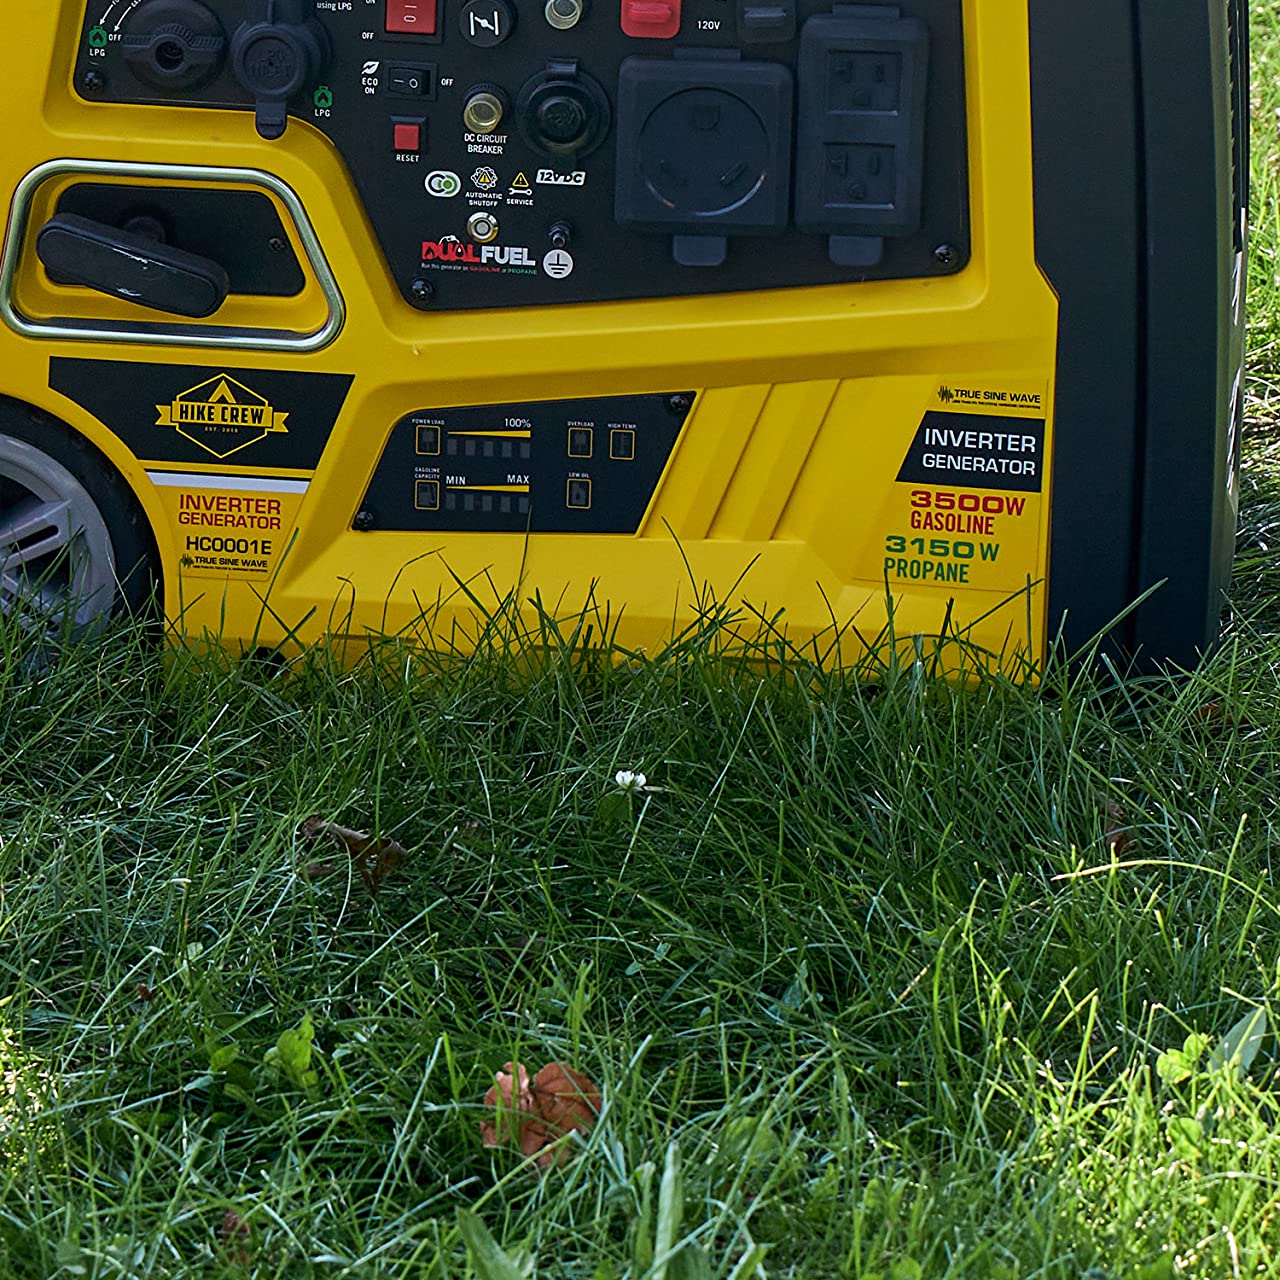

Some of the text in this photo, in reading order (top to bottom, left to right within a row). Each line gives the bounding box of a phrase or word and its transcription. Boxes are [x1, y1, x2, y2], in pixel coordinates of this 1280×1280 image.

[316, 1, 353, 12] using LPG
[696, 20, 721, 30] 120V
[108, 33, 122, 42] OFF
[361, 32, 375, 40] OFF
[89, 48, 106, 57] LPG
[361, 77, 378, 86] ECO
[440, 78, 454, 87] OFF
[364, 86, 375, 95] ON
[314, 108, 331, 118] LPG
[464, 133, 508, 144] DC CIRCUIT
[467, 144, 503, 155] BREAKER
[396, 154, 420, 163] RESET
[465, 191, 503, 200] AUTOMATIC
[468, 199, 498, 207] SHUTOFF
[506, 198, 534, 206] SERVICE
[422, 241, 536, 267] DUAL FUEL
[954, 388, 1041, 404] TRUE SINE WAVE
[179, 404, 265, 424] HIKE CREW
[504, 418, 531, 428] 100%
[925, 428, 1036, 453] INVERTER
[922, 453, 1036, 476] GENERATOR
[445, 475, 466, 486] MIN
[506, 474, 530, 484] MAX
[179, 494, 281, 515] INVERTER
[178, 512, 281, 530] GENERATOR
[910, 510, 995, 535] GASOLINE
[885, 535, 1000, 562] 3150 W
[195, 556, 268, 568] TRUE SINE WAVE
[884, 557, 969, 583] PROPANE
